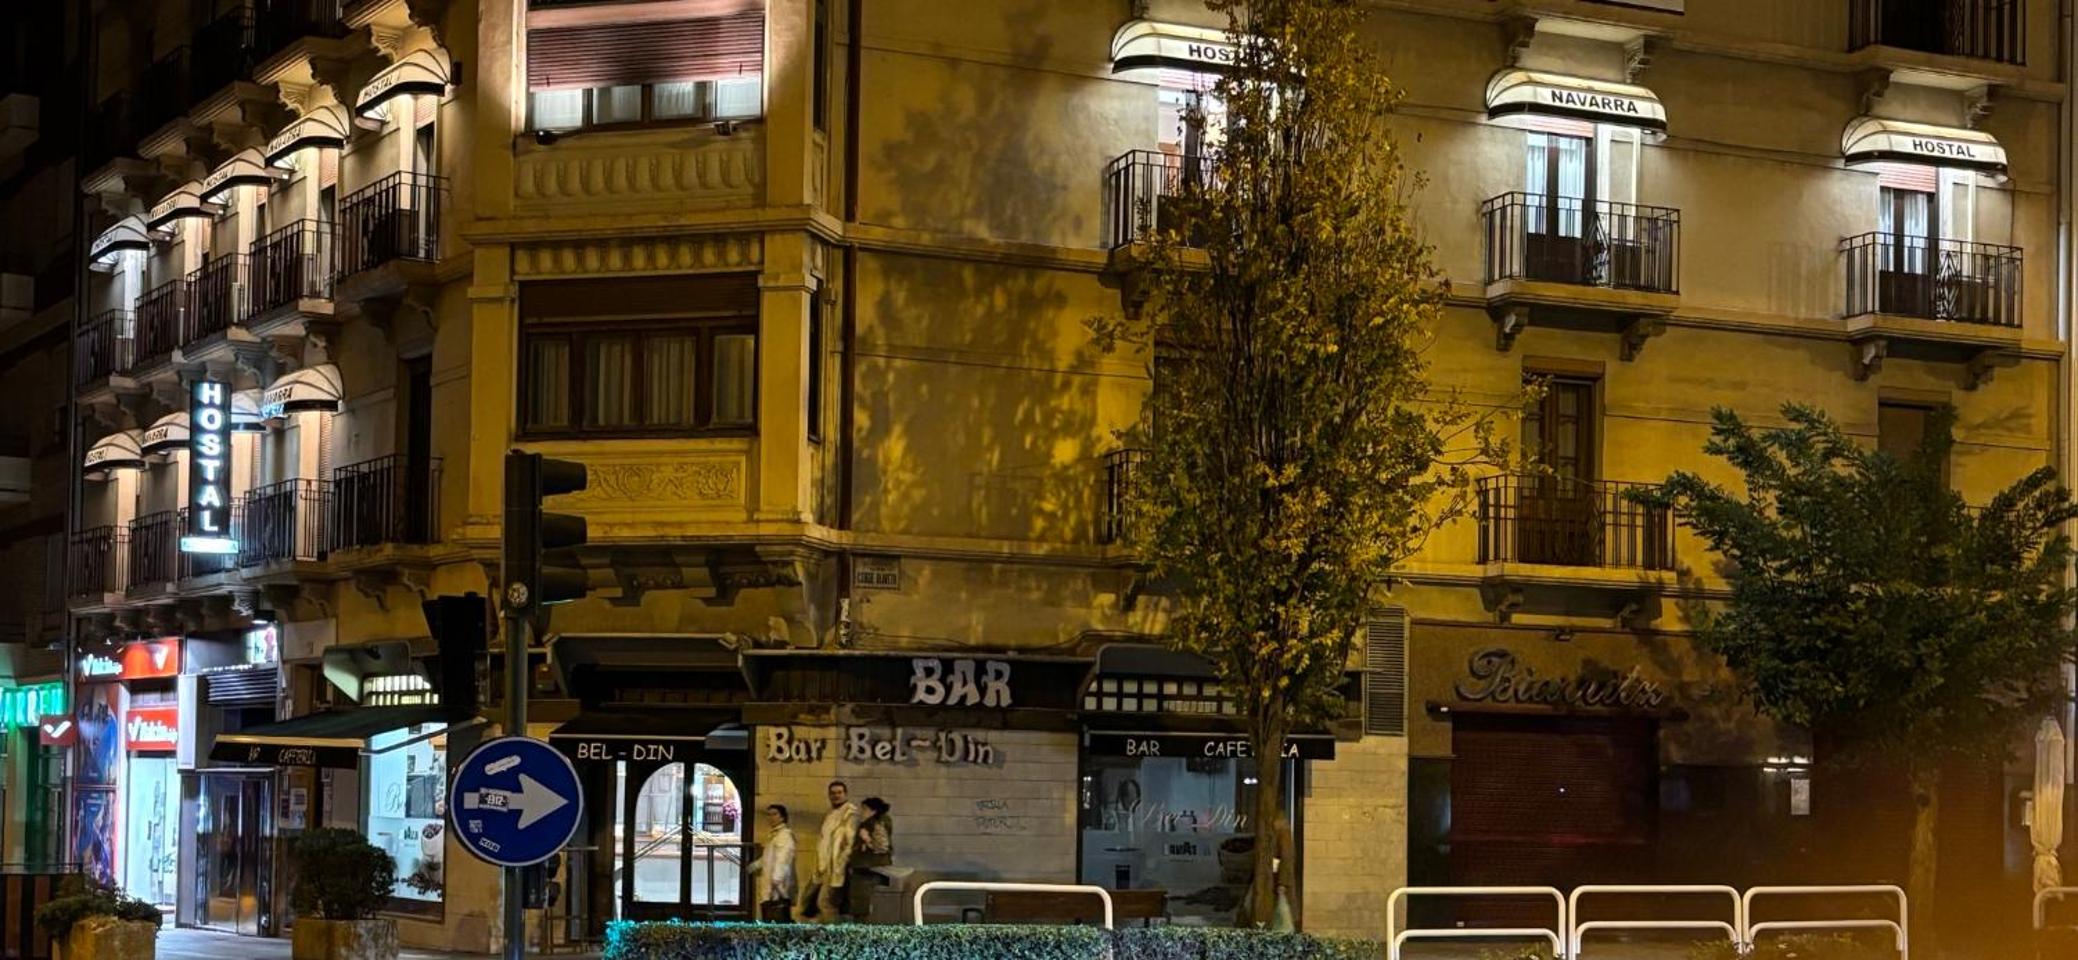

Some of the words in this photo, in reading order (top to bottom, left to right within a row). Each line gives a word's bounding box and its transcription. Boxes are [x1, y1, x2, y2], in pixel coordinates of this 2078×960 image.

[1551, 89, 1638, 114] NAVARRA
[1912, 138, 1976, 158] HOSTAL
[200, 382, 223, 532] HOSTAL
[911, 657, 1013, 707] BAR
[766, 726, 828, 764] Bar
[1125, 738, 1161, 757] BAR
